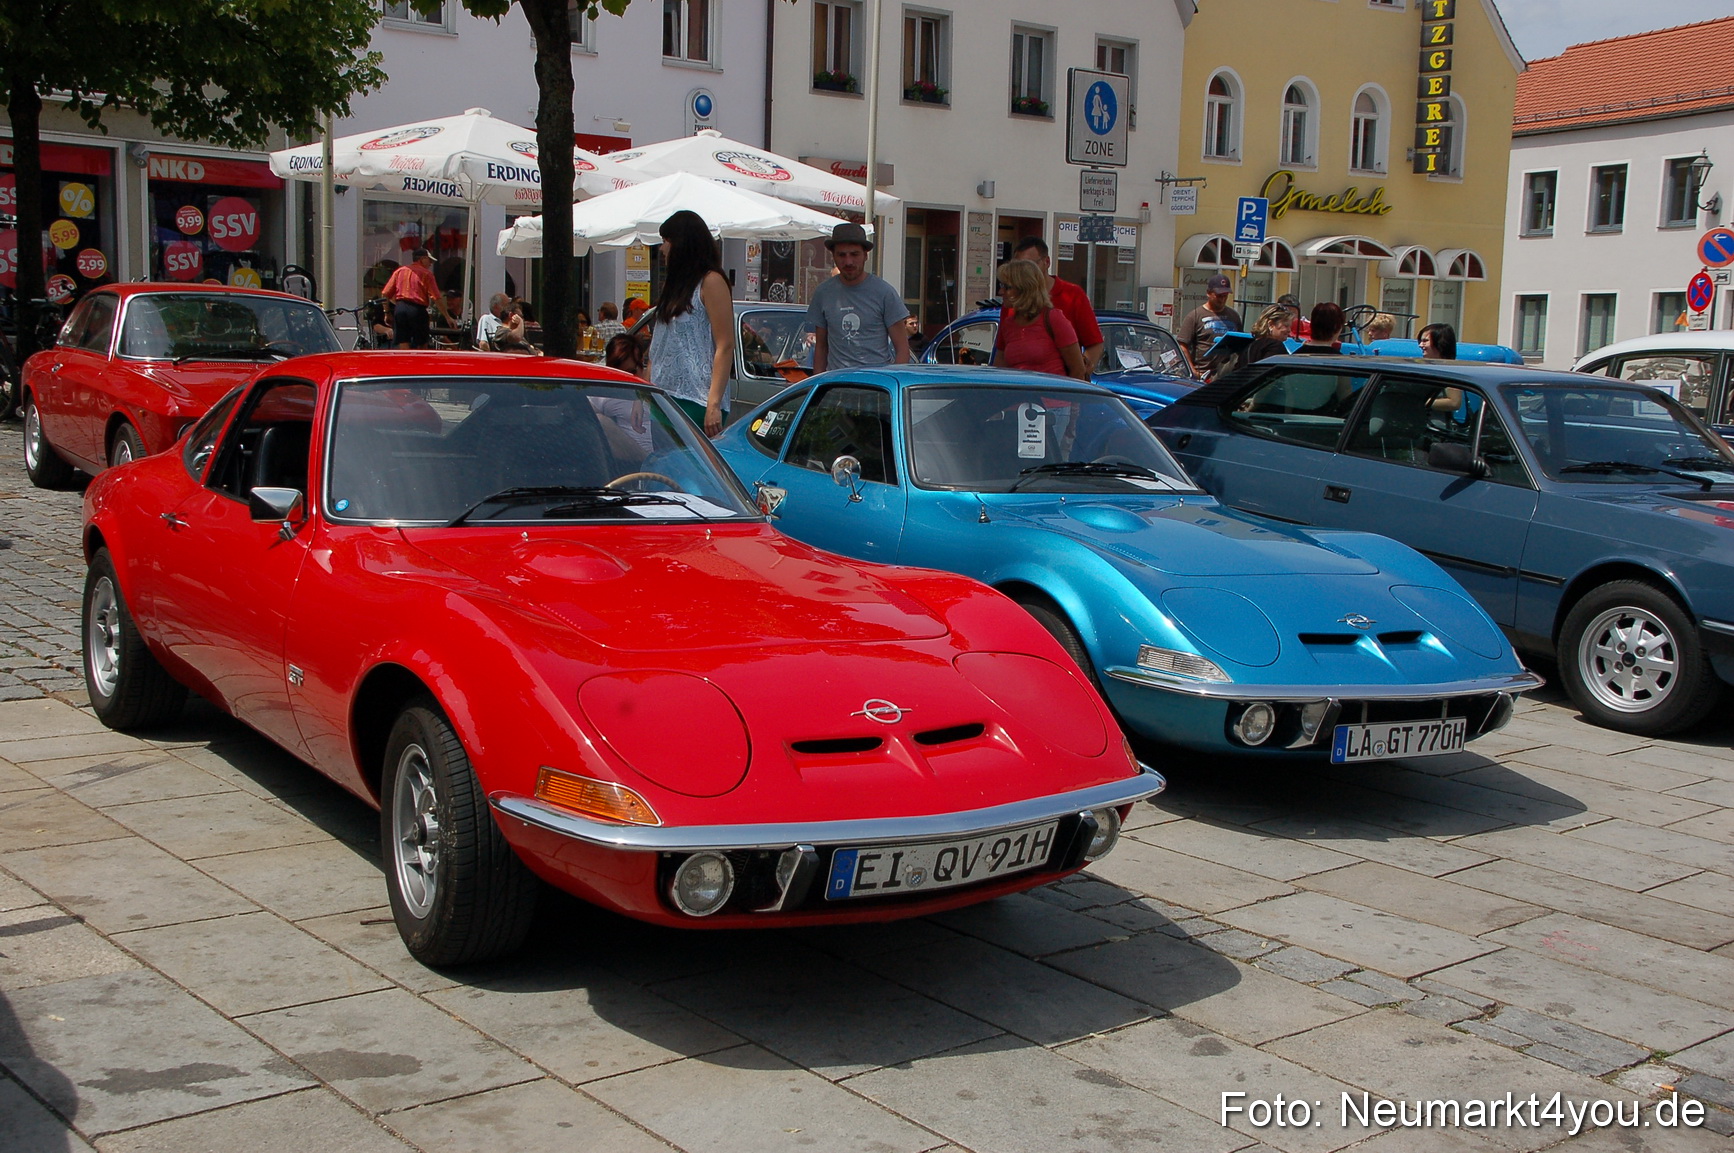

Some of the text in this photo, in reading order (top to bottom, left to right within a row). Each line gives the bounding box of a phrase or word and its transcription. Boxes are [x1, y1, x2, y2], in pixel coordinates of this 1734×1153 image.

[1085, 140, 1114, 157] ZONE
[150, 158, 205, 181] NKD
[289, 155, 324, 171] ERDINGE
[830, 160, 868, 179] Juweli
[487, 162, 541, 184] ERDING
[819, 189, 866, 208] Weißbier
[1261, 170, 1393, 220] Gmelch
[1241, 201, 1257, 221] P
[177, 215, 202, 228] 9,99
[211, 212, 256, 239] SSV
[51, 227, 79, 244] 5,99
[78, 258, 106, 272] 2,99
[167, 251, 200, 272] SSV
[777, 411, 795, 421] GT
[768, 426, 786, 437] 1970
[1346, 729, 1371, 757] LA
[1387, 726, 1414, 754] GT
[1417, 722, 1465, 753] 770H
[835, 826, 1055, 891] D EI QV 91H
